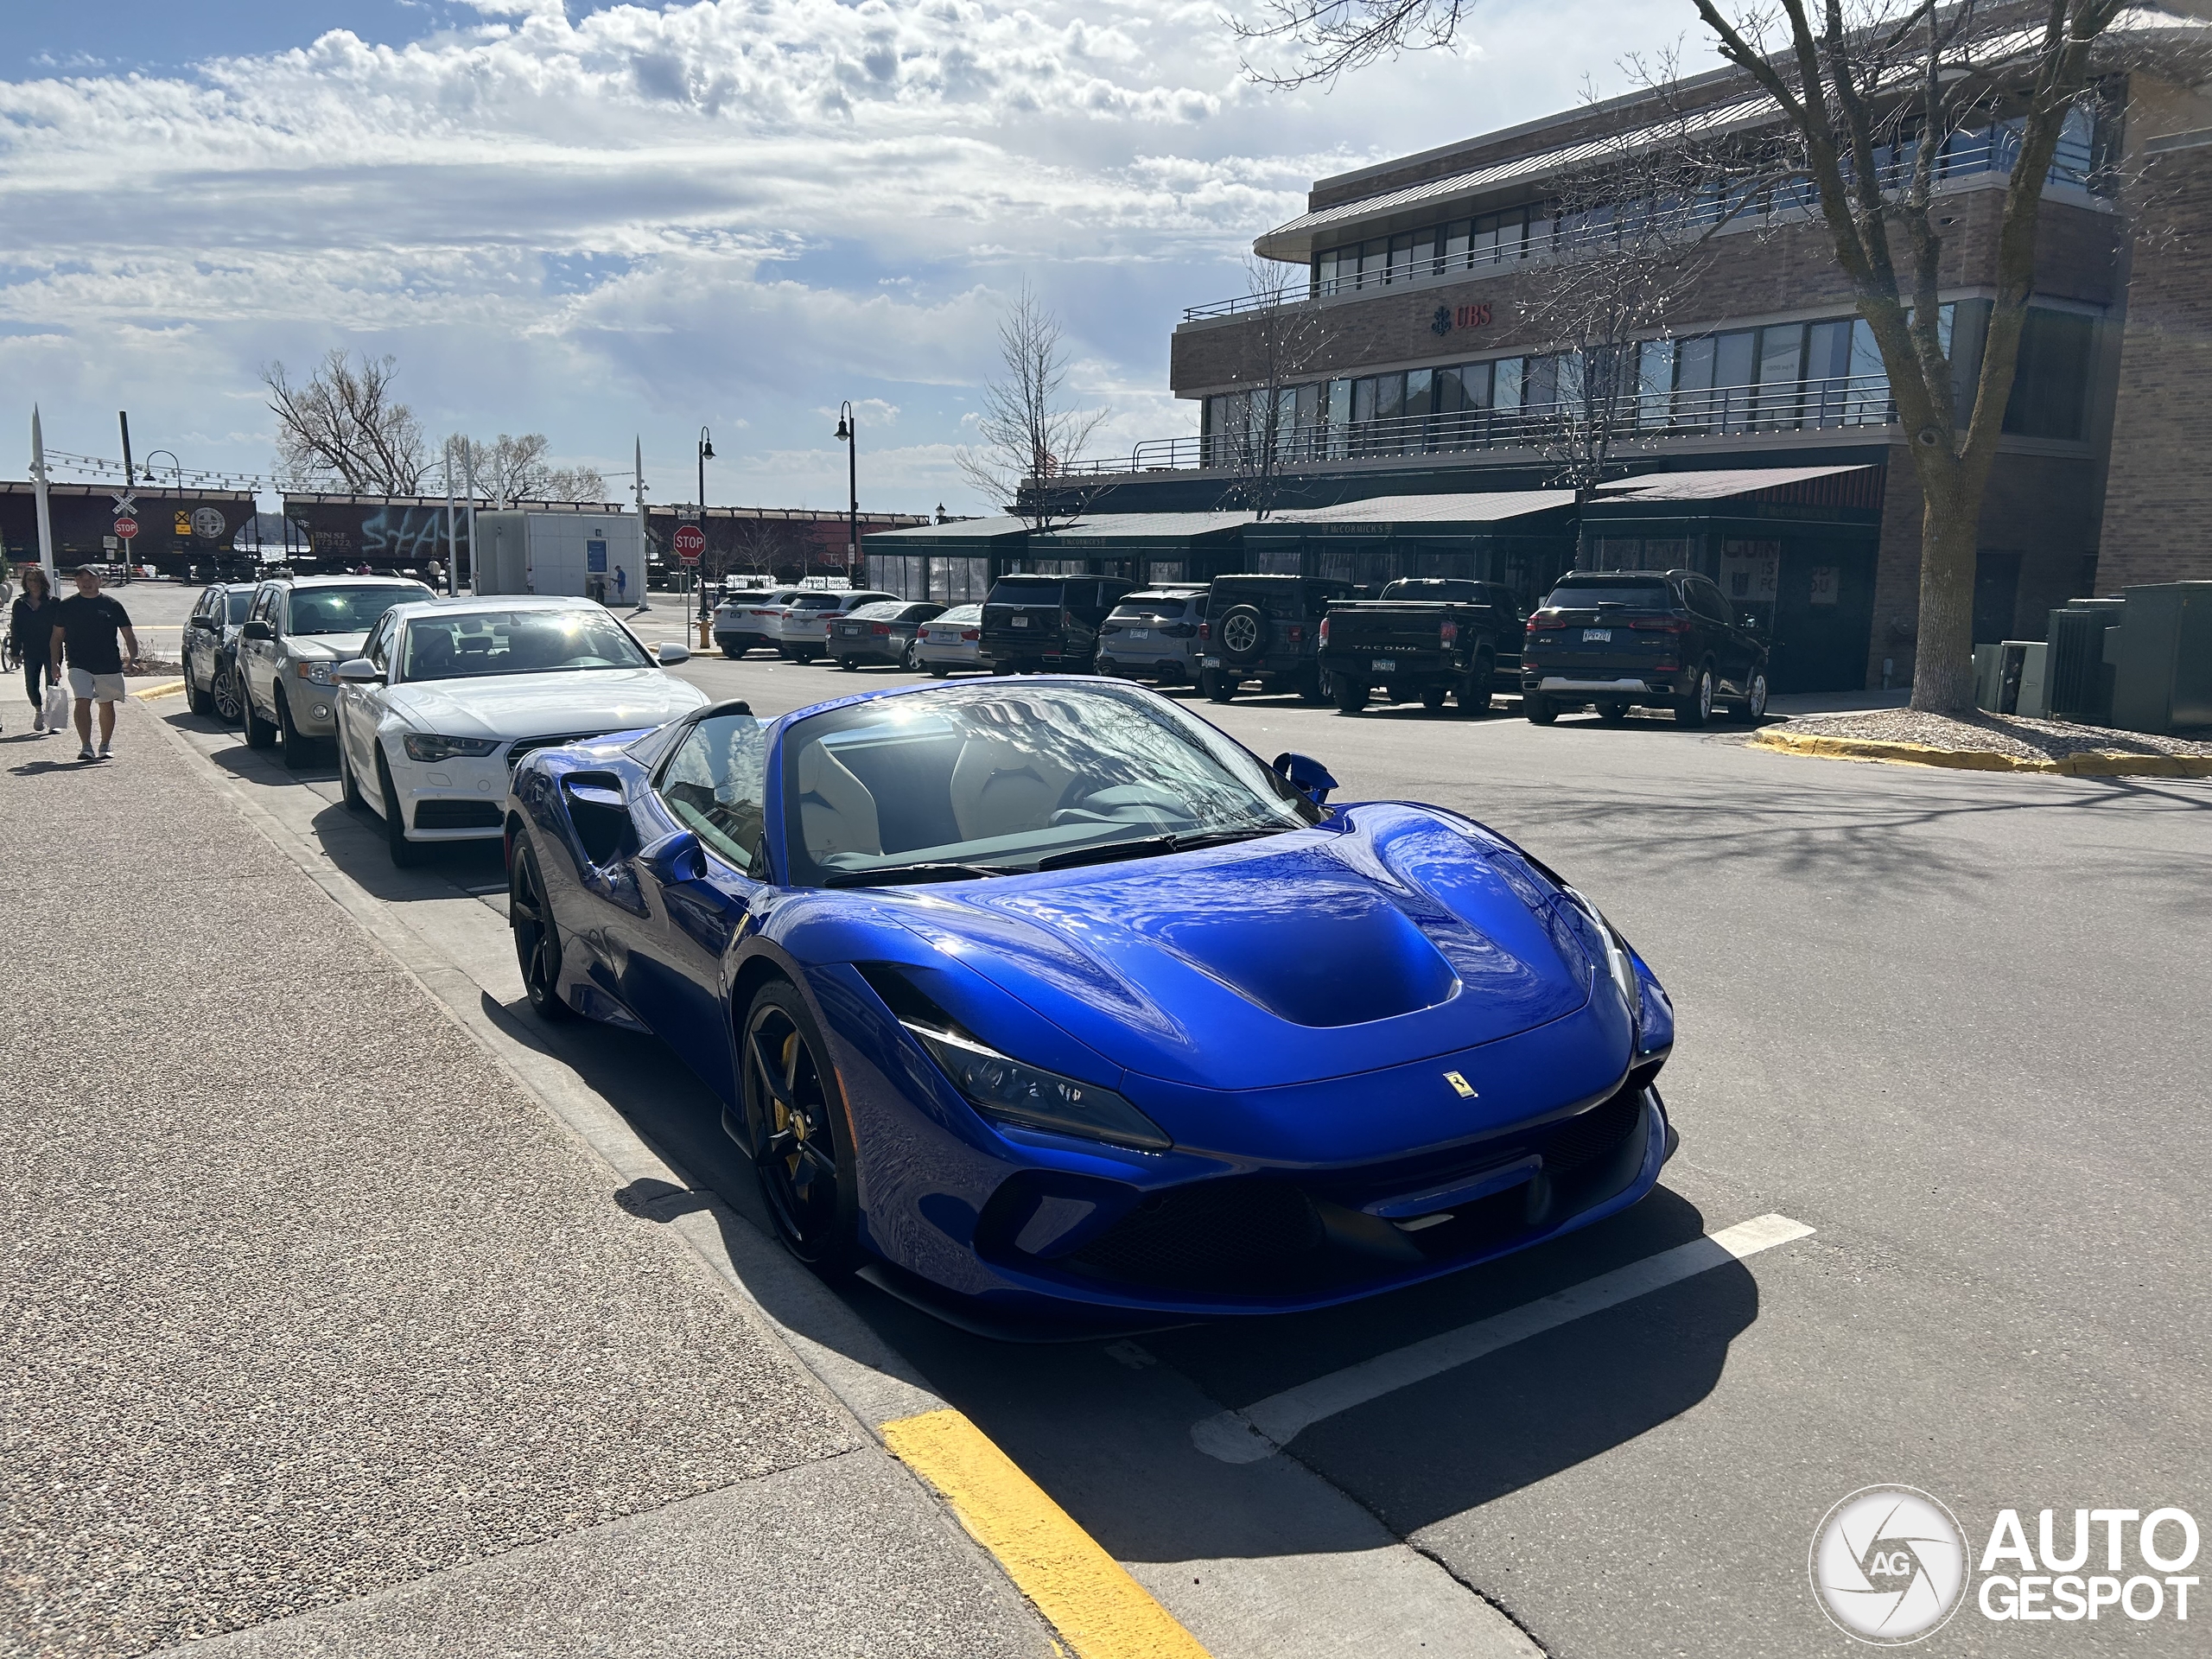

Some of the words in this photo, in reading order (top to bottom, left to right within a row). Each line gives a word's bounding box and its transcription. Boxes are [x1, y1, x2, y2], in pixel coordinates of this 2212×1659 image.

[1454, 303, 1492, 329] UBS
[113, 493, 136, 512] CROSSING
[115, 524, 137, 532] STOP
[676, 536, 703, 549] STOP
